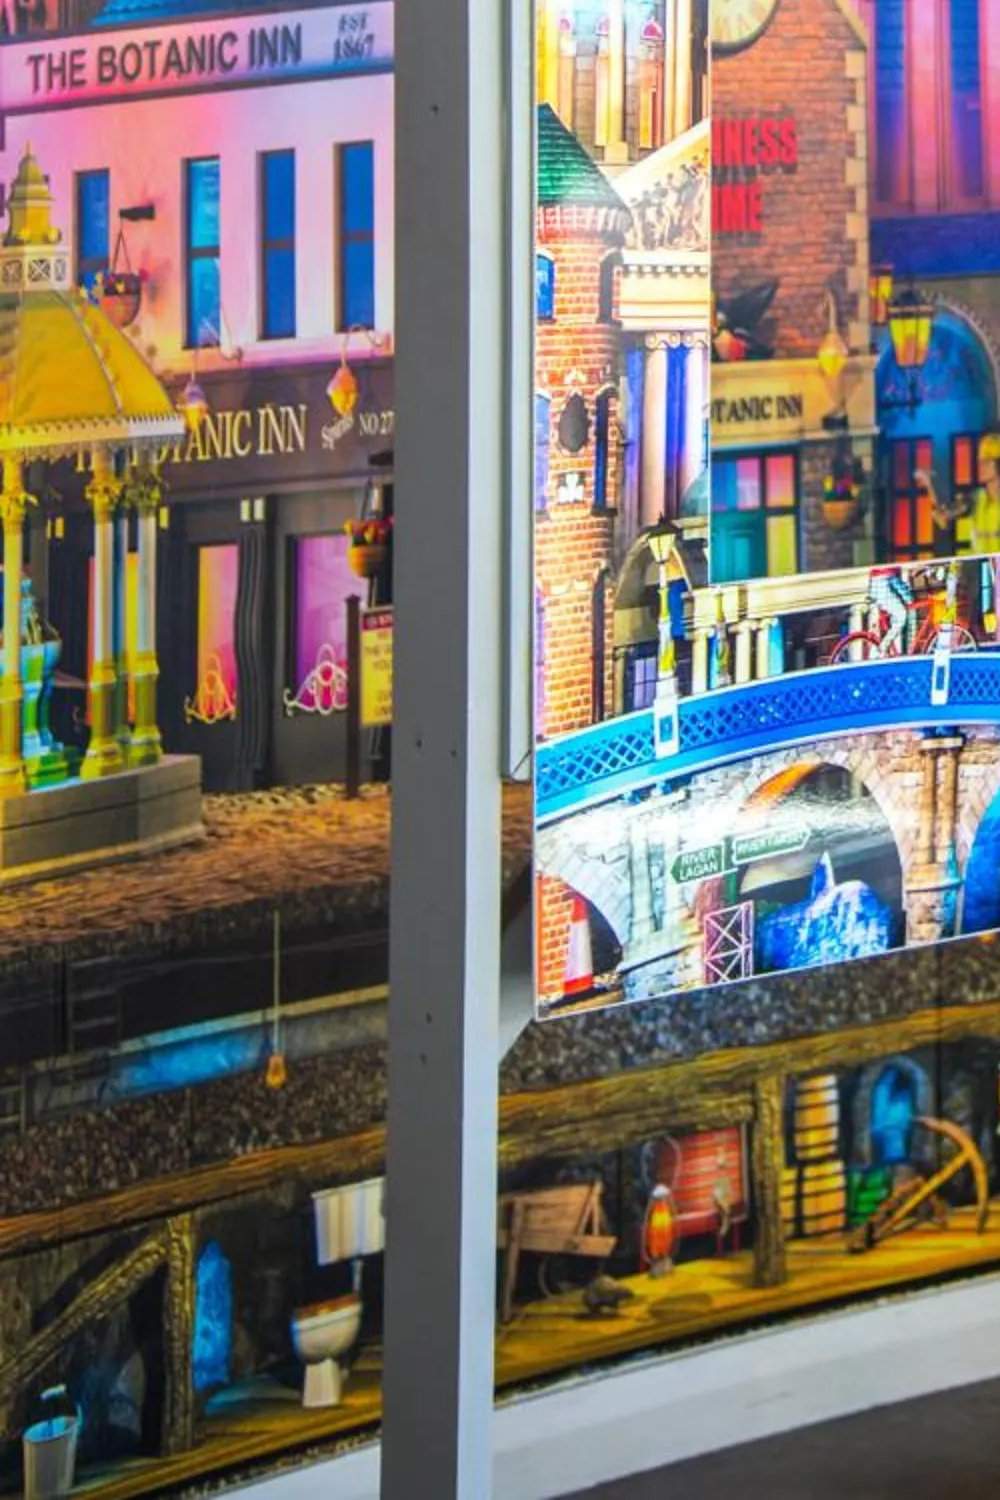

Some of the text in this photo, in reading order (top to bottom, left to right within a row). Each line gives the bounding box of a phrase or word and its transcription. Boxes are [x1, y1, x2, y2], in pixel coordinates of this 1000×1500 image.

[26, 22, 303, 93] THE BOTANIC INN
[258, 403, 308, 455] INN
[679, 862, 719, 881] LAGAN
[681, 846, 718, 867] RIVER
